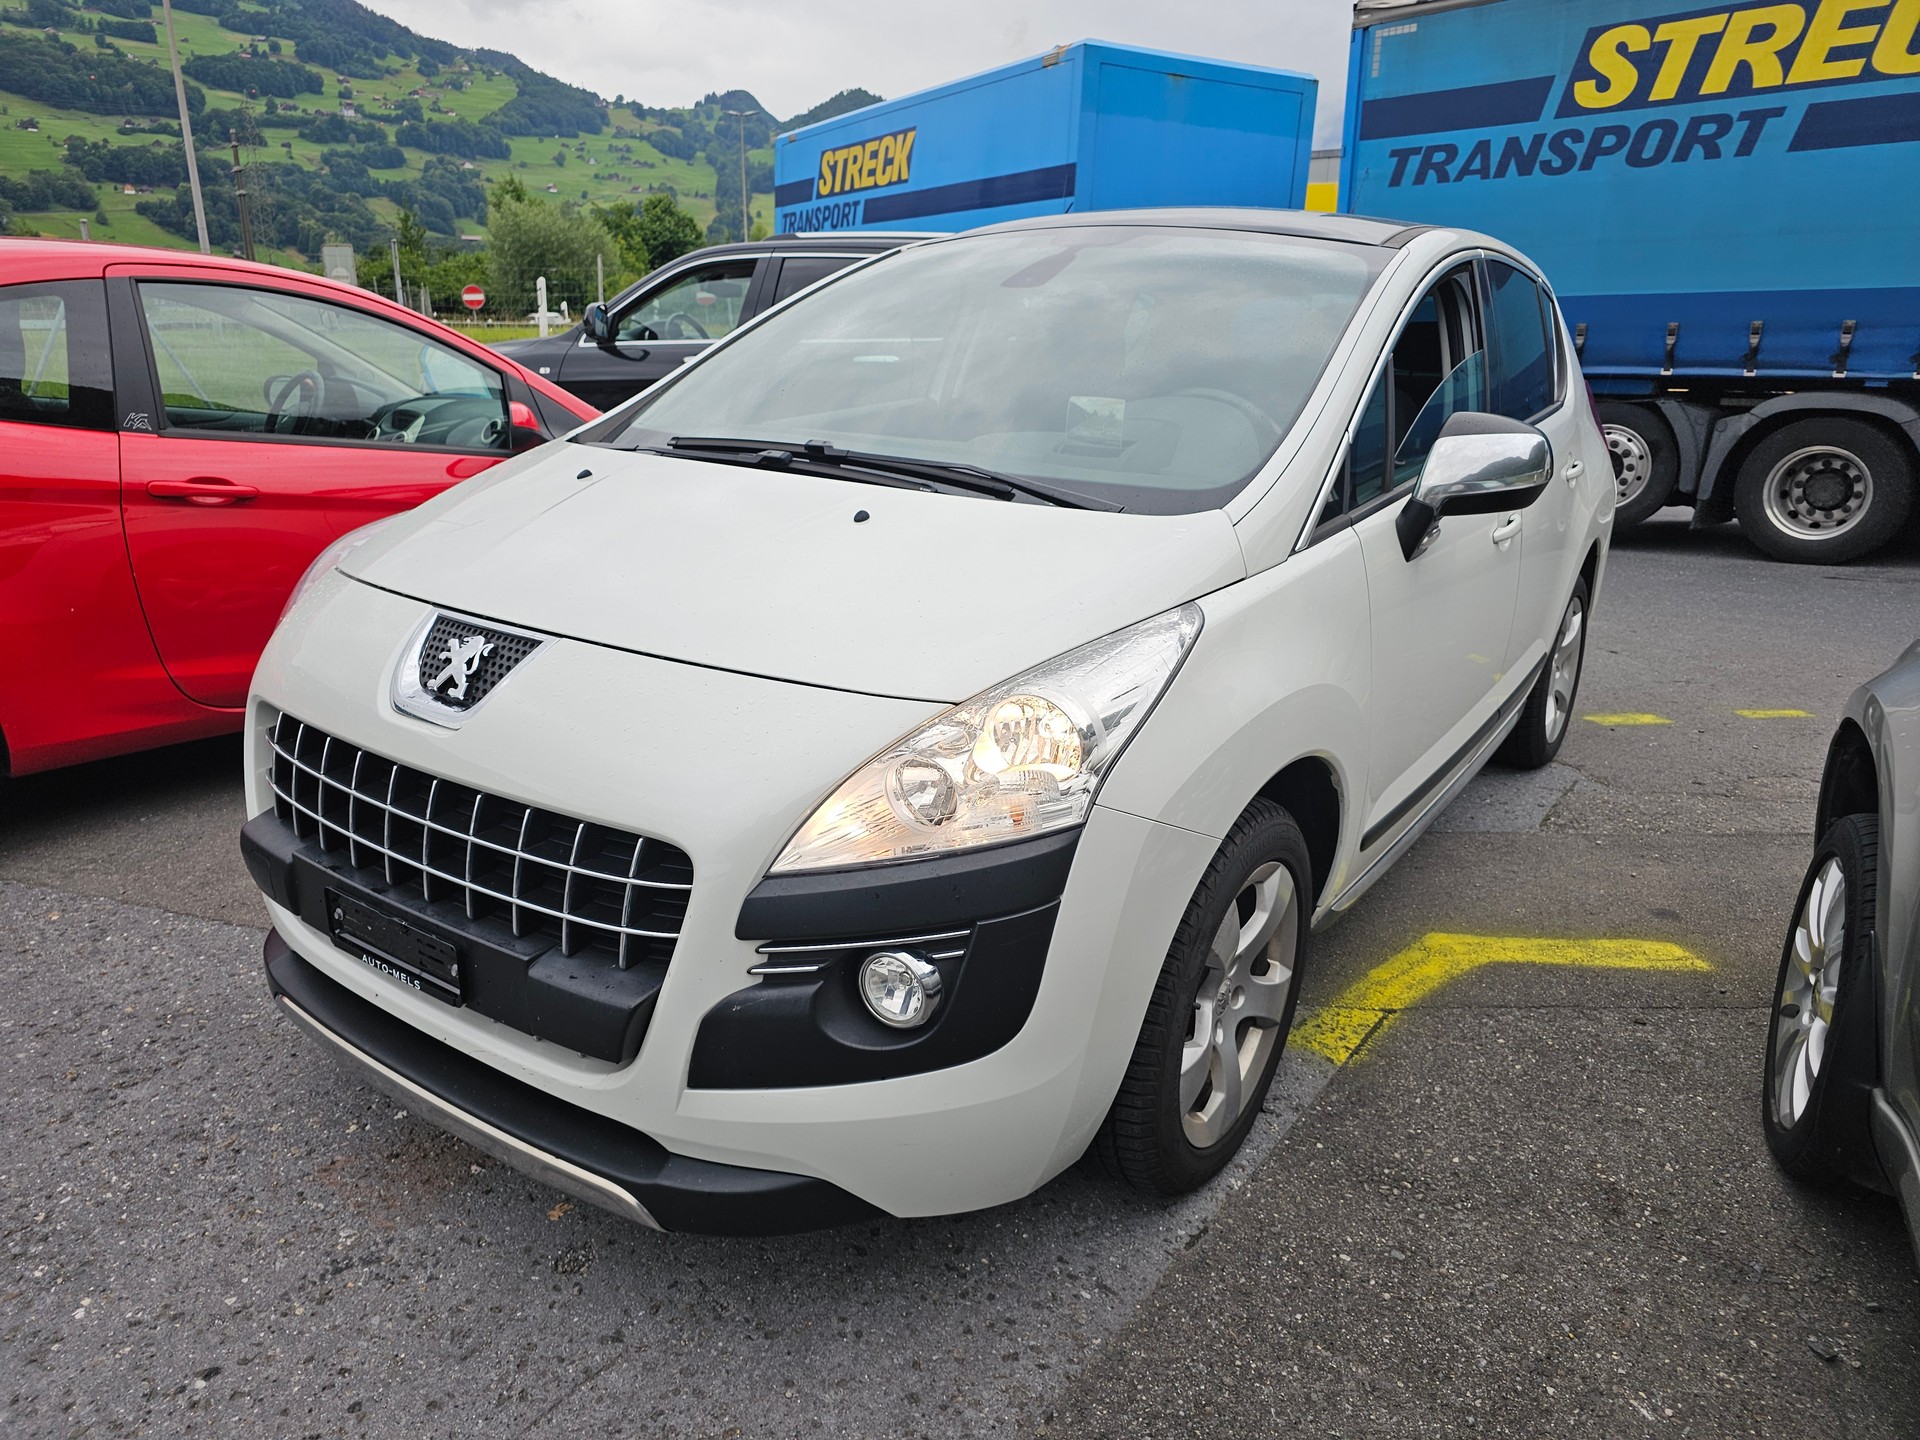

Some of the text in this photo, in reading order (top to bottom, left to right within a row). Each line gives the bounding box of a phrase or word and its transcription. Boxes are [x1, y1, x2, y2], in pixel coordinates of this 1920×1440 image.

[818, 130, 917, 196] STRECK
[1387, 105, 1788, 188] TRANSPORT
[782, 200, 861, 233] TRANSPORT
[361, 954, 421, 990] AUTO-MELS
